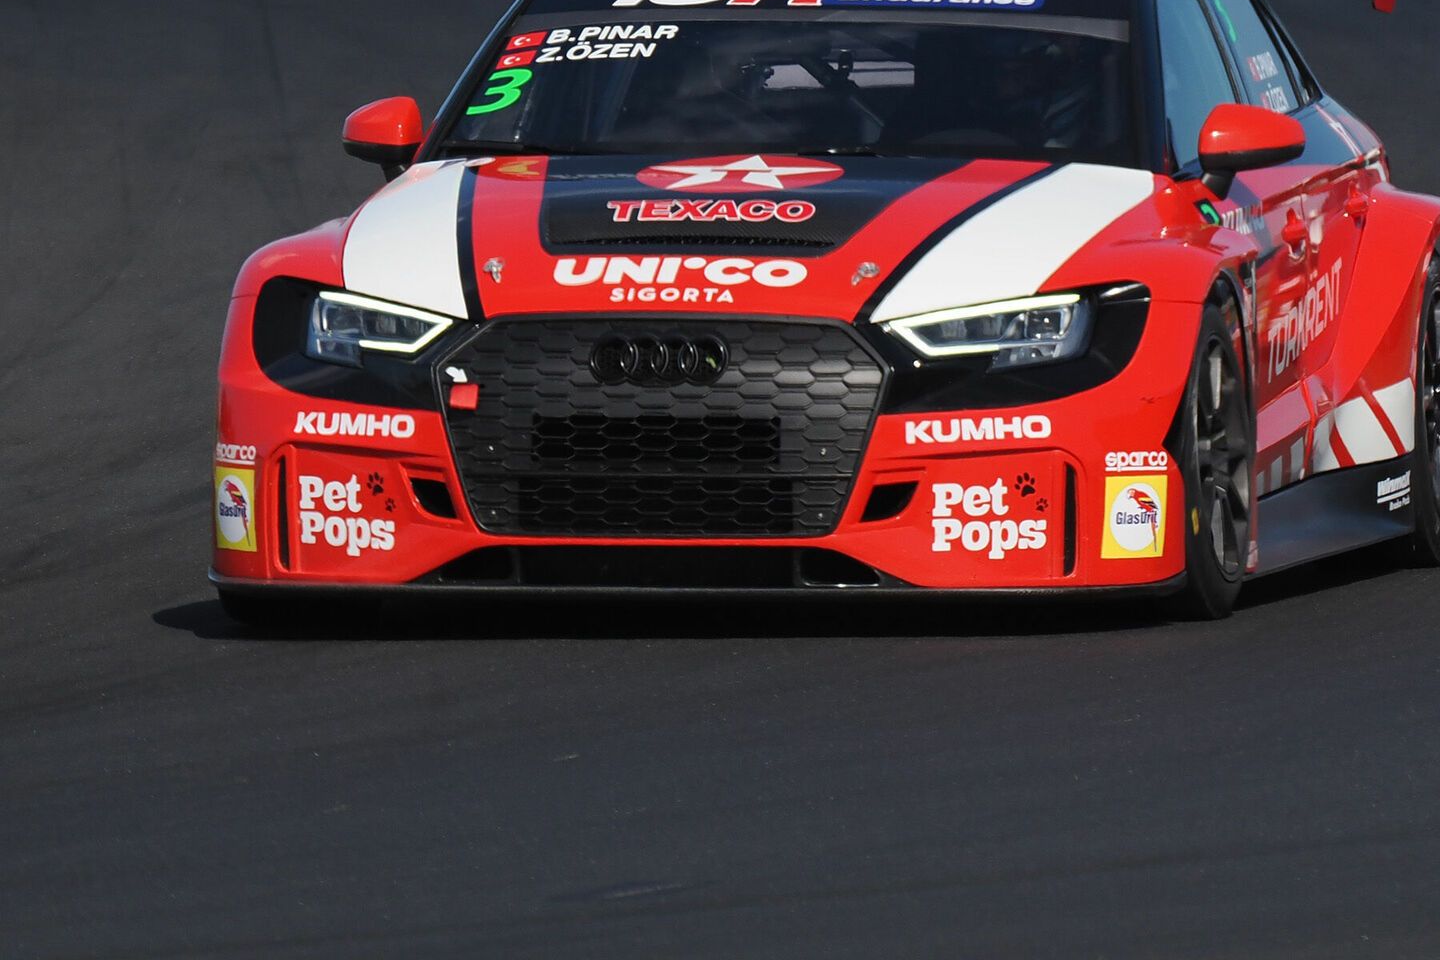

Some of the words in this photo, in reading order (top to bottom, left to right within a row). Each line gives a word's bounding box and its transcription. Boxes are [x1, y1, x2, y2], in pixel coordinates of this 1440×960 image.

[546, 24, 679, 44] B.PINAR
[535, 41, 656, 63] Z.ÖZEN
[465, 68, 533, 116] 3
[607, 200, 816, 223] TEXACO
[294, 411, 414, 438] KUMHO
[905, 415, 1052, 444] KUMHO
[216, 442, 257, 461] sparco
[1105, 451, 1168, 472] sparco
[299, 471, 362, 512] Pet
[932, 478, 1009, 517] Pet
[300, 511, 396, 556] Pops
[931, 518, 1048, 559] Pops
